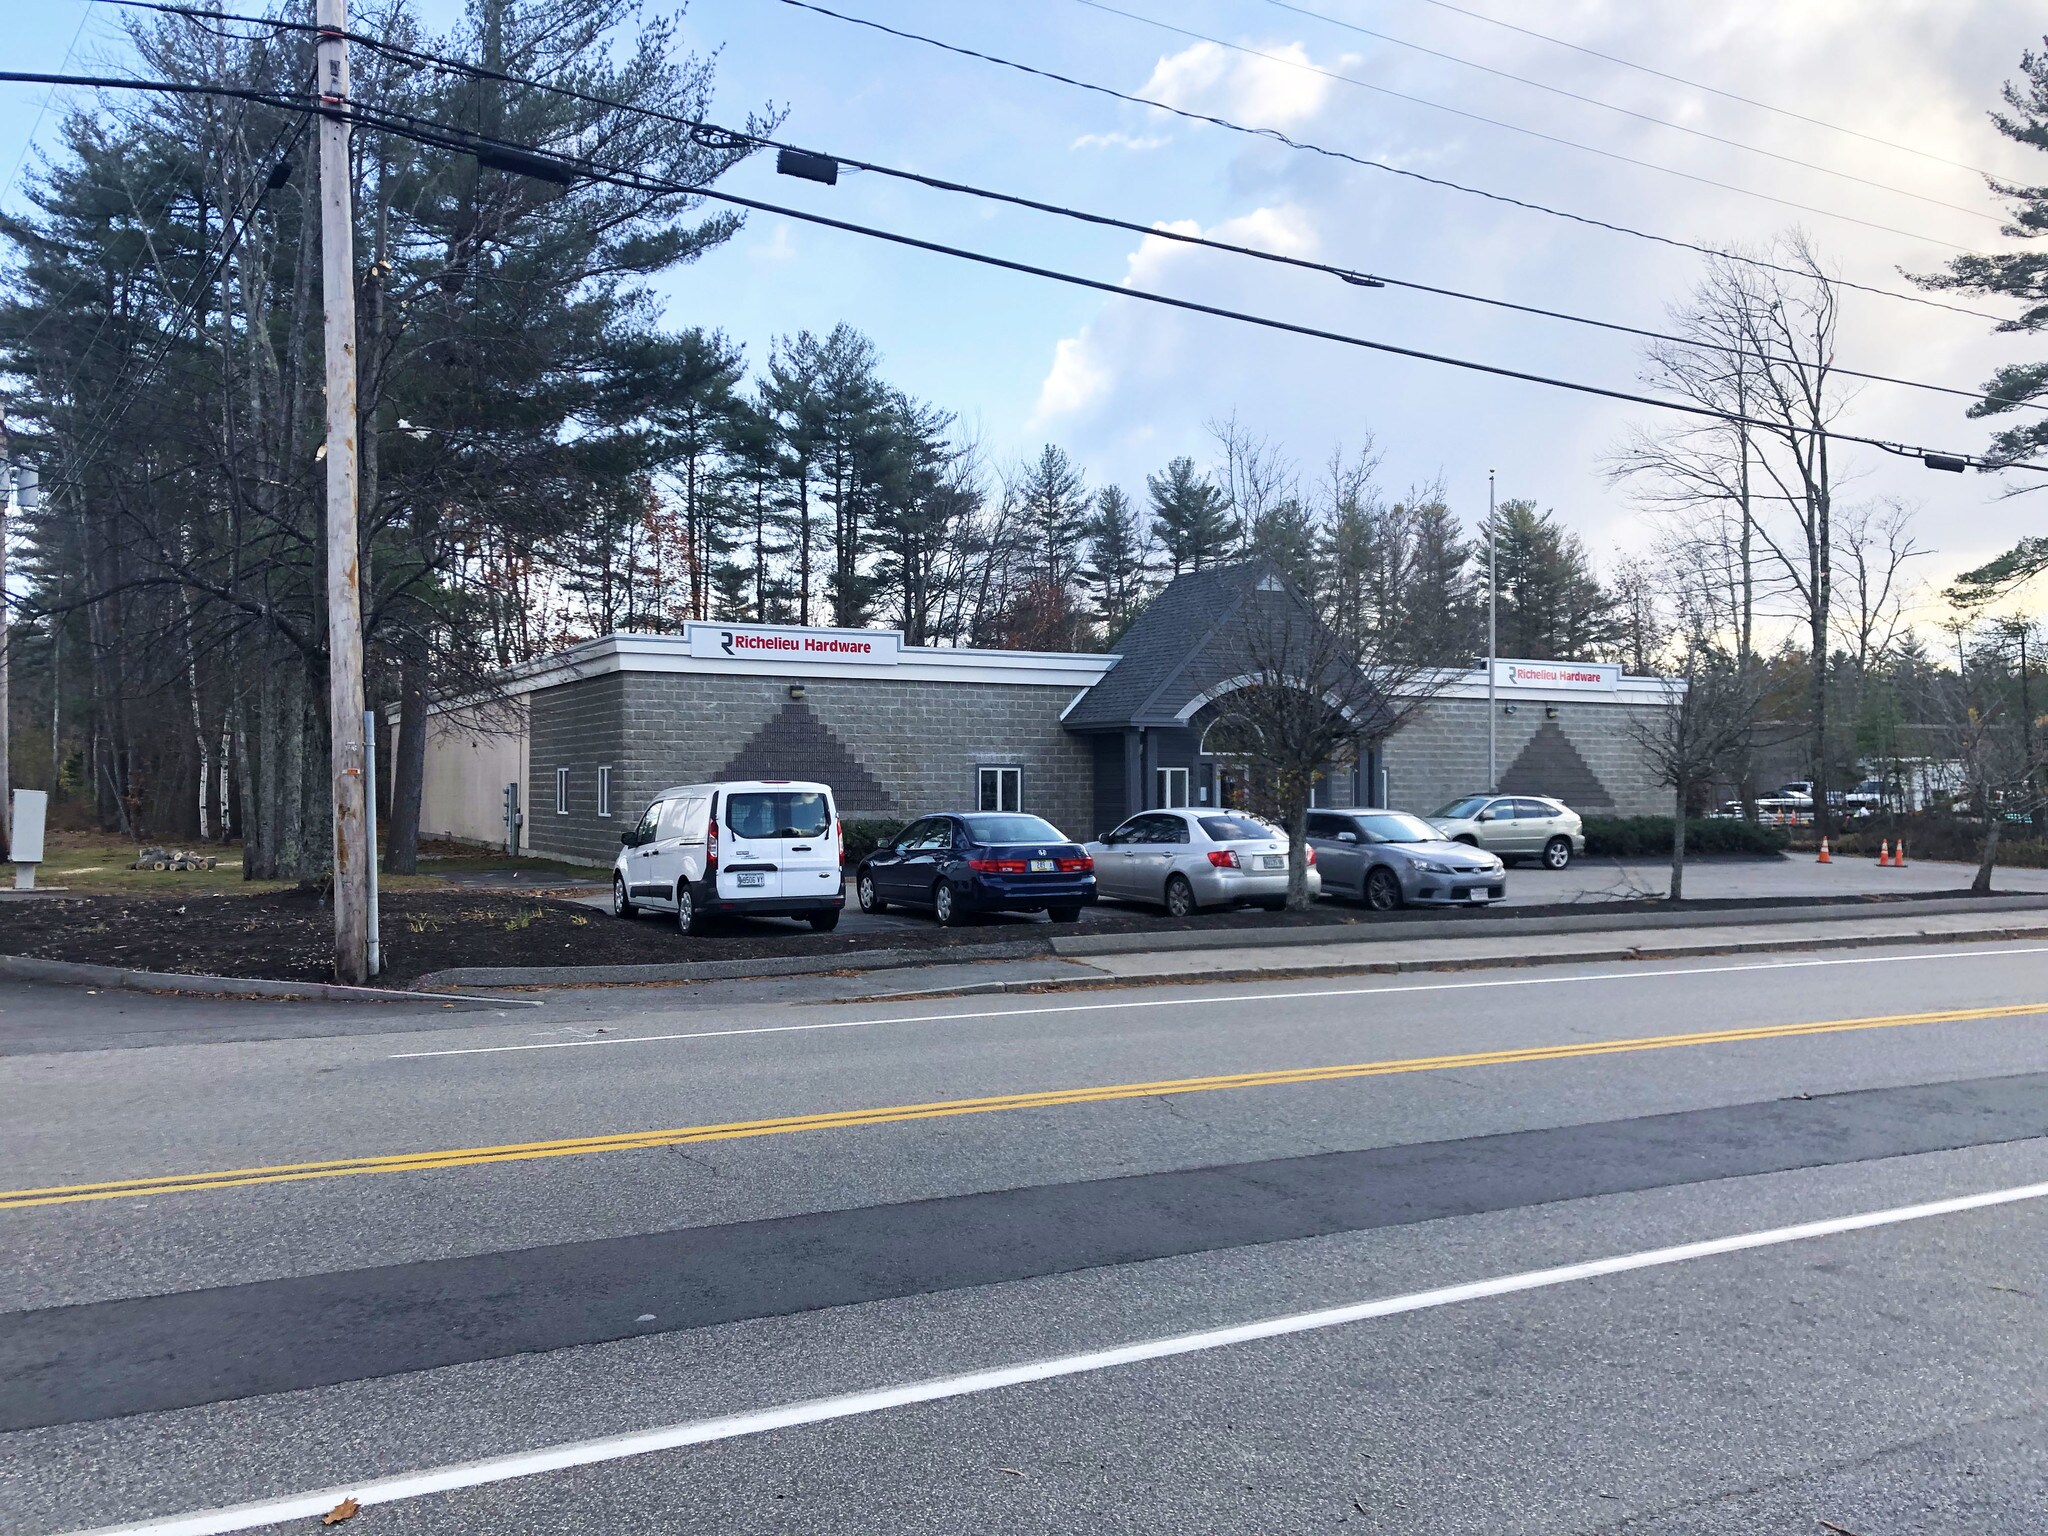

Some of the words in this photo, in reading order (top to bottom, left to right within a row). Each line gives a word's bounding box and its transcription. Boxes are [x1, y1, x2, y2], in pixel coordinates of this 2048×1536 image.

[735, 635, 799, 651] Richelieu
[804, 638, 871, 653] Hardware
[1517, 669, 1556, 680] Richelieu
[1559, 671, 1600, 682] Hardware
